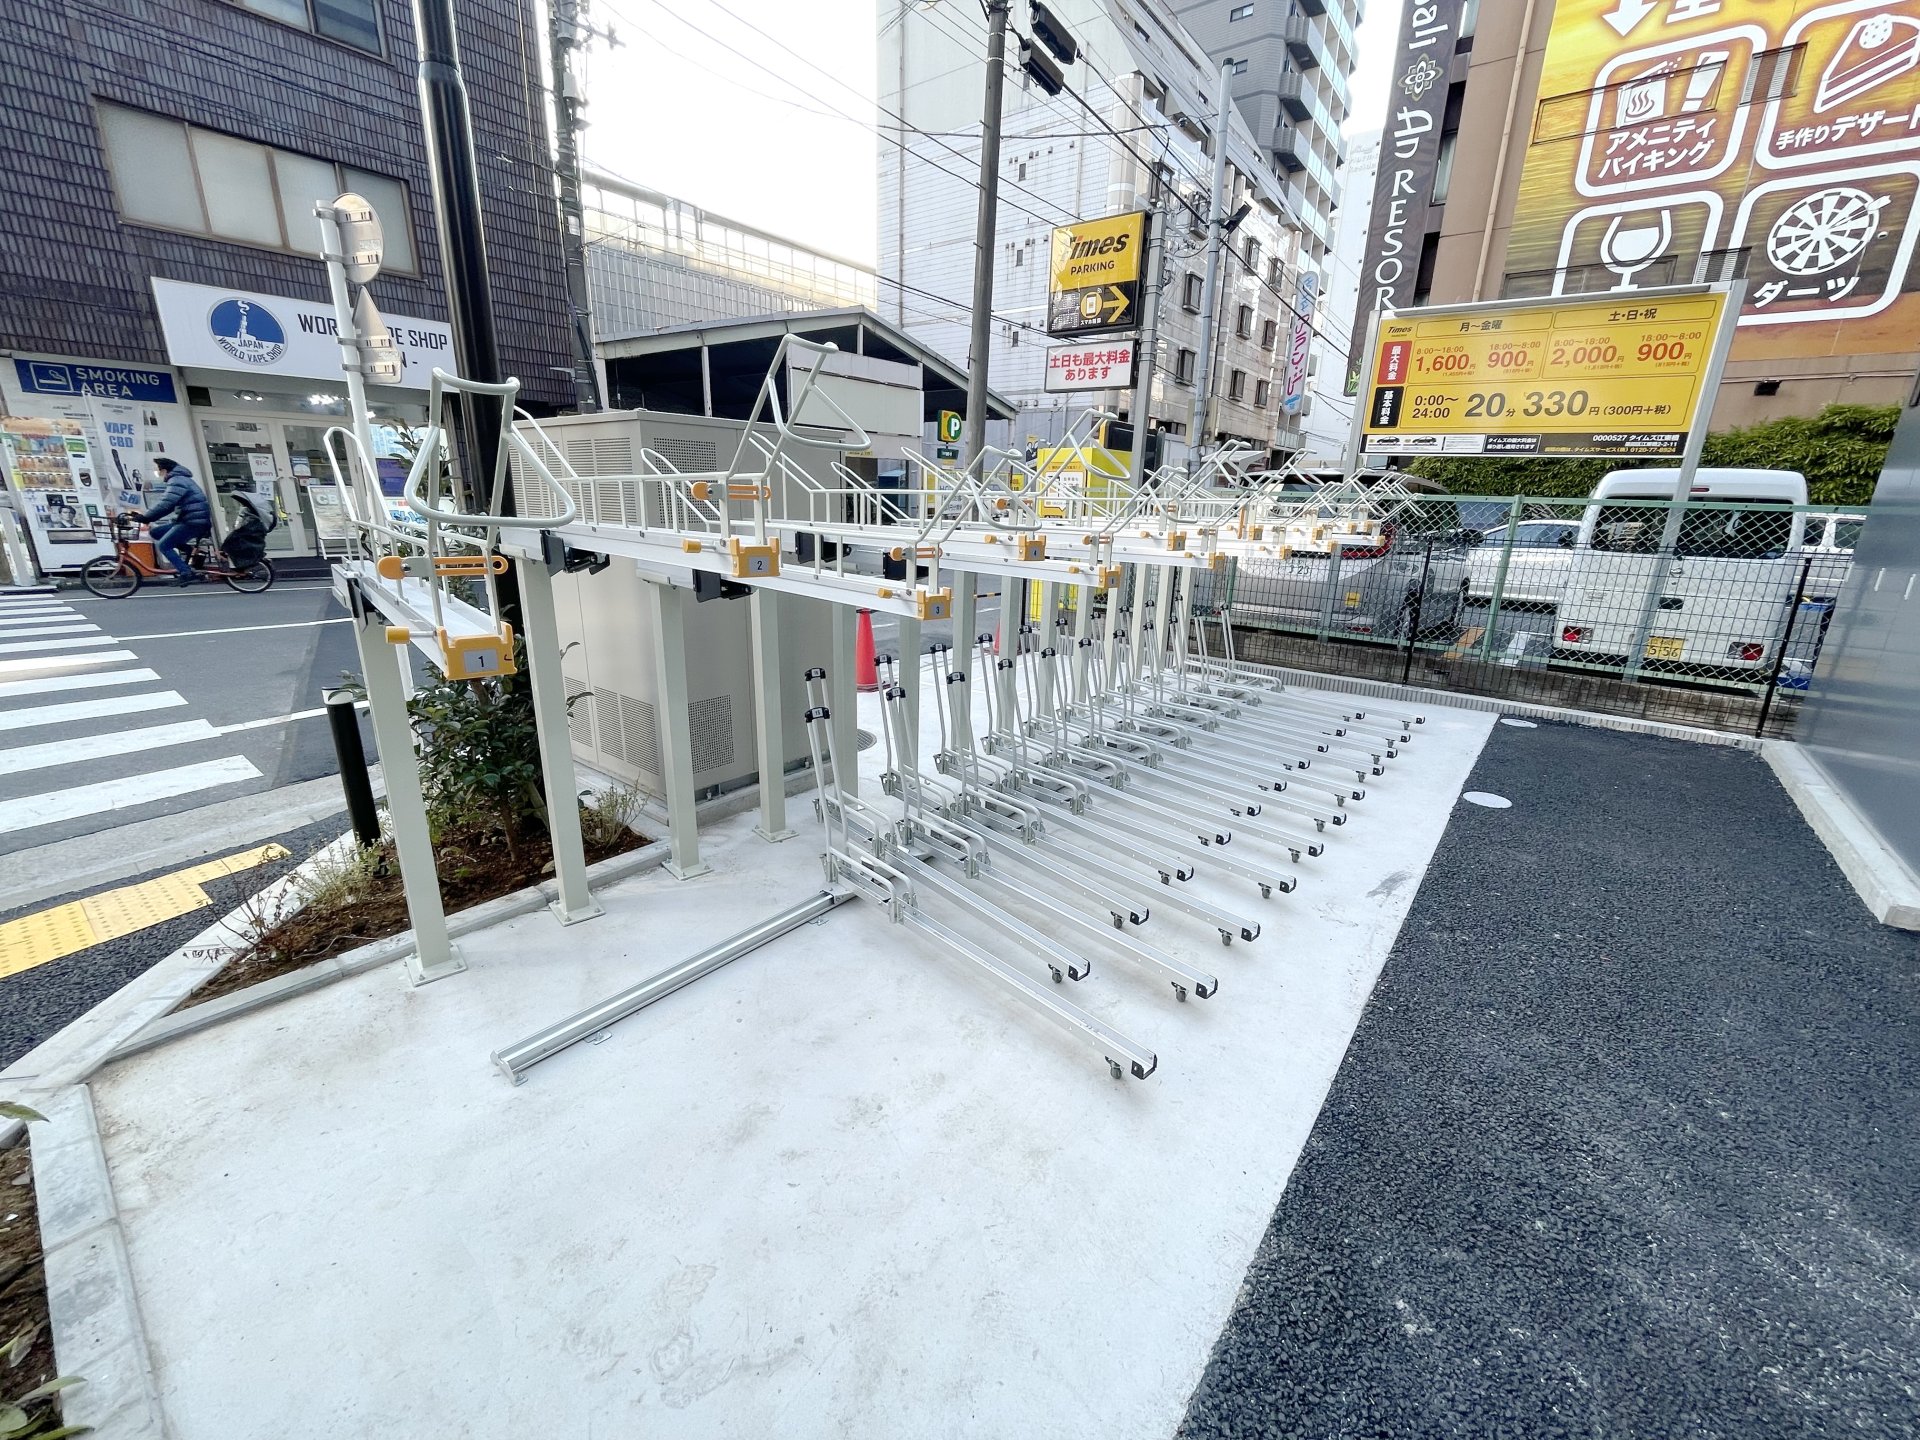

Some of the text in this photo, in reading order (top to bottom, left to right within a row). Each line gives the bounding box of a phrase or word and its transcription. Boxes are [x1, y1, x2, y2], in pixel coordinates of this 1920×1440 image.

[1408, 0, 1448, 49] ali
[1603, 118, 1717, 156] アメニティ
[1598, 139, 1717, 179] バイキング
[1374, 168, 1416, 312] RESOR
[1070, 260, 1115, 276] PARKING
[1753, 275, 1861, 309] ダーツ
[1608, 308, 1658, 322] 土・日・祝
[297, 313, 339, 337] WOR
[408, 329, 448, 350] SHOP
[1387, 326, 1413, 334] Times
[1459, 320, 1503, 332] 月～金曜
[218, 337, 284, 363] WORLD VAPE SHOP
[237, 340, 264, 350] JAPAN
[1049, 349, 1131, 369] 土日も最大料金
[1387, 345, 1402, 381] 最大料金
[75, 367, 161, 386] SMOKING
[1065, 366, 1112, 381] あります
[81, 382, 133, 397] AREA
[1379, 390, 1395, 425] 基本料金
[1412, 407, 1450, 419] 24:00
[104, 421, 135, 435] VAPE
[950, 418, 960, 437] P
[109, 435, 134, 448] CBD
[1592, 434, 1626, 442] 0000527
[757, 560, 763, 571] 2
[936, 606, 940, 614] 3
[478, 655, 484, 667] 1
